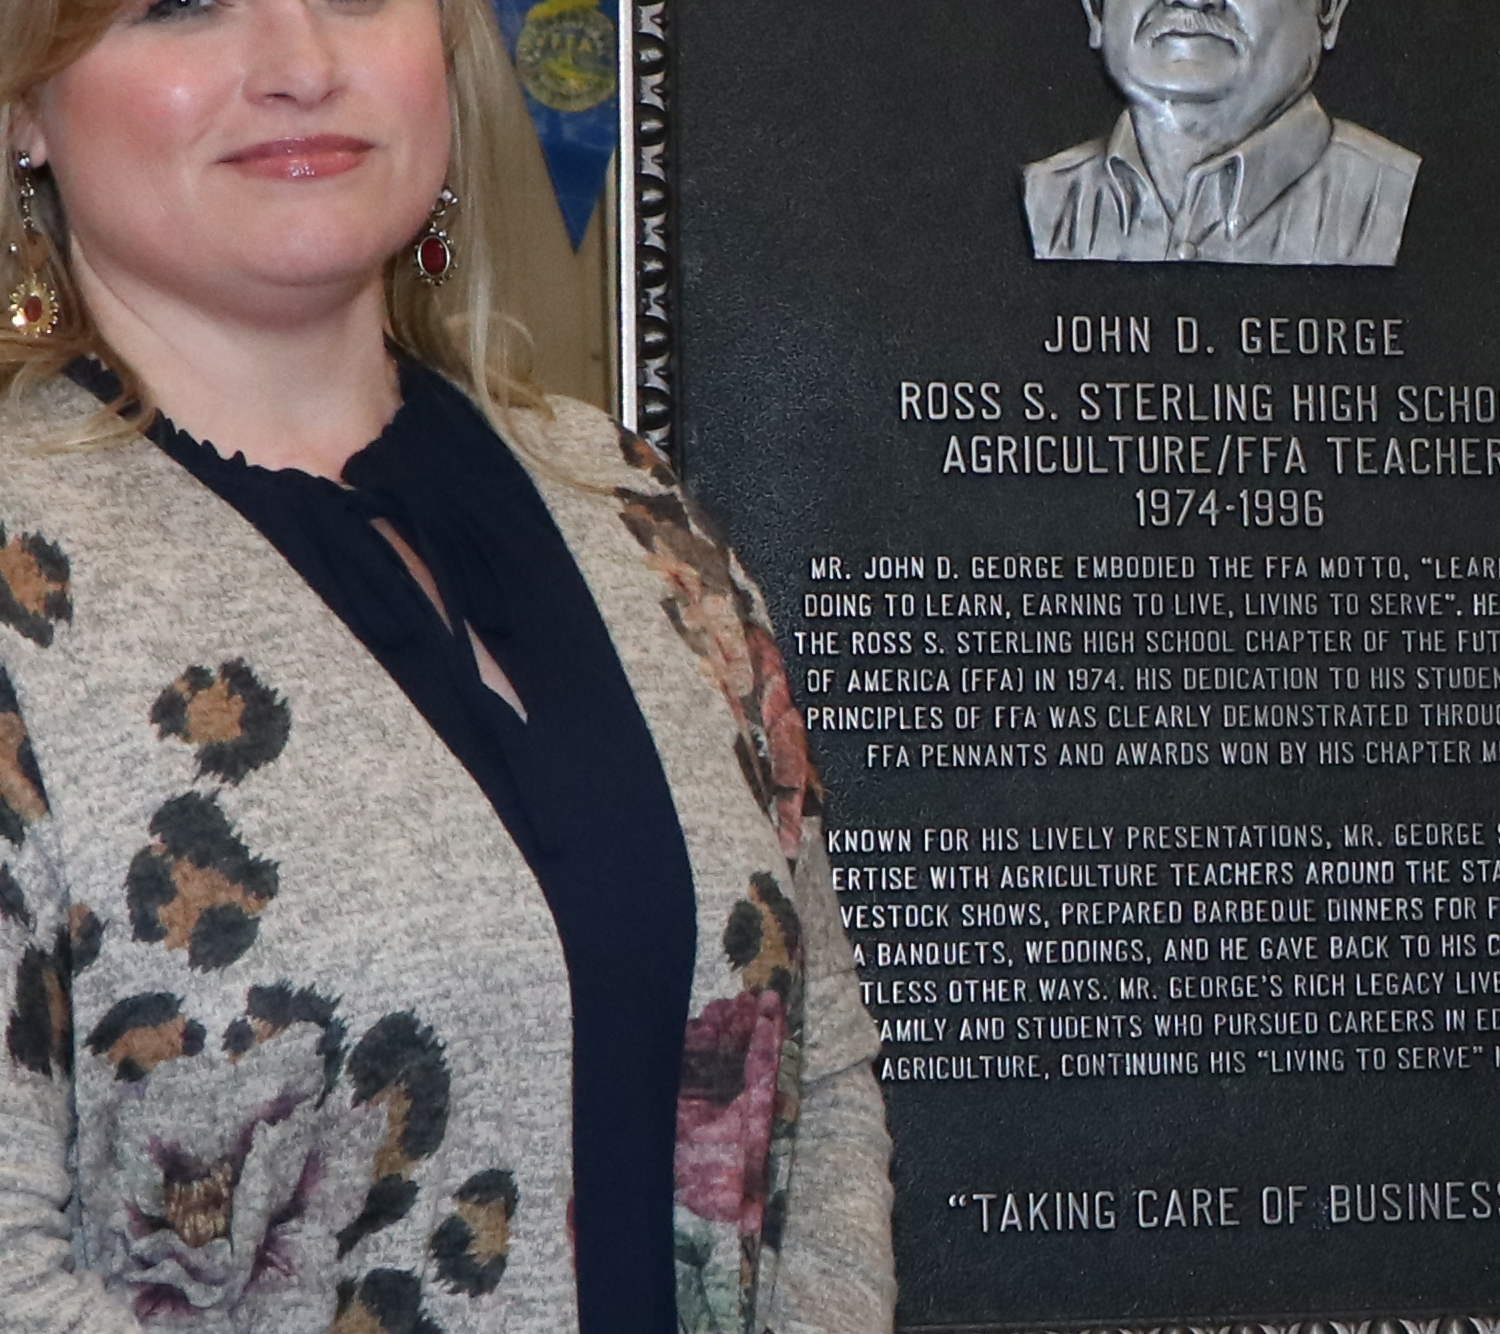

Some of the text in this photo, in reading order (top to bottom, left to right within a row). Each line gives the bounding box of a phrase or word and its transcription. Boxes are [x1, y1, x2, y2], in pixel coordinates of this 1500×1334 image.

[1044, 315, 1406, 355] JOHN D. GEORGE
[900, 380, 1002, 420] ROSS
[1023, 381, 1058, 421] S.
[1079, 381, 1273, 421] STERLING
[1292, 383, 1378, 422] HIGH
[942, 434, 1308, 474] AGRICULTURE/FFA
[1135, 487, 1324, 526] 1974-1996
[811, 555, 851, 580] MR.
[864, 555, 925, 580] JOHN
[936, 555, 959, 579] D.
[971, 555, 1064, 579] GEORGE
[1076, 555, 1195, 578] EMBODIED
[1208, 554, 1254, 578] THE
[1265, 555, 1308, 579] FFA
[1320, 555, 1410, 580] MOTTO,
[804, 592, 872, 617] DOING
[884, 592, 915, 617] TO
[926, 592, 1011, 619] LEARN,
[1022, 592, 1122, 616] EARNING
[1132, 592, 1164, 616] TO
[1174, 591, 1234, 618] LIVE,
[1245, 592, 1318, 615] LIVING
[1329, 592, 1359, 615] TO
[1473, 592, 1500, 616] HE
[794, 630, 838, 654] THE
[851, 630, 912, 654] ROSS
[923, 630, 947, 654] S.
[956, 630, 1072, 654] STERLING
[1083, 630, 1135, 654] HIGH
[1146, 630, 1236, 653] SCHOOL
[1245, 628, 1352, 652] CHAPTER
[1363, 629, 1390, 652] OF
[1401, 629, 1447, 652] THE
[806, 667, 835, 694] OF
[847, 668, 950, 692] AMERICA
[1035, 667, 1056, 691] IN
[1067, 667, 1125, 691] 1974.
[1136, 667, 1172, 691] HIS
[1183, 666, 1318, 690] DEDICATION
[1328, 666, 1360, 690] TO
[1370, 666, 1406, 689] HIS
[807, 705, 944, 730] PRINCIPLES
[955, 705, 984, 729] OF
[994, 705, 1038, 729] FFA
[1048, 704, 1097, 729] WAS
[1108, 704, 1212, 728] CLEARLY
[1223, 703, 1409, 727] DEMONSTRATED
[866, 743, 911, 768] FFA
[921, 742, 1048, 767] PENNANTS
[1058, 742, 1104, 766] AND
[1115, 741, 1210, 766] AWARDS
[1220, 741, 1269, 765] WON
[1279, 741, 1307, 765] BY
[1318, 740, 1355, 764] HIS
[1365, 739, 1471, 764] CHAPTER
[827, 828, 911, 854] KNOWN
[924, 827, 969, 851] FOR
[982, 826, 1020, 852] HIS
[1031, 826, 1114, 850] LIVELY
[1127, 824, 1332, 849] PRESENTATIONS,
[1343, 823, 1383, 847] MR.
[1394, 822, 1485, 847] GEORGE
[831, 866, 919, 892] ERTISE
[929, 865, 989, 890] WITH
[1000, 862, 1158, 888] AGRICULTURE
[1169, 860, 1294, 886] TEACHERS
[1305, 859, 1394, 885] AROUND
[1404, 858, 1451, 884] THE
[839, 904, 950, 930] VESTOCK
[961, 902, 1050, 927] SHOWS,
[1061, 899, 1182, 925] PREPARED
[1193, 898, 1316, 923] BARBEQUE
[1327, 896, 1424, 922] DINNERS
[1434, 896, 1477, 920] FOR
[877, 940, 1014, 966] BANQUETS,
[1025, 938, 1152, 964] WEDDINGS,
[1164, 936, 1209, 961] AND
[1220, 936, 1249, 961] HE
[1260, 935, 1318, 960] GAVE
[1329, 934, 1389, 959] BACK
[1399, 933, 1431, 958] TO
[1441, 933, 1477, 957] HIS
[859, 980, 938, 1005] TLESS
[948, 978, 1027, 1003] OTHER
[1038, 976, 1109, 1001] WAYS.
[1119, 976, 1159, 1000] MR.
[1294, 972, 1345, 997] RICH
[1355, 971, 1445, 996] LEGACY
[873, 1017, 948, 1043] AMILY
[959, 1016, 1005, 1041] AND
[1016, 1014, 1143, 1040] STUDENTS
[1154, 1013, 1203, 1037] WHO
[1214, 1011, 1318, 1035] PURSUED
[1329, 1009, 1435, 1033] CAREERS
[1445, 1008, 1466, 1031] IN
[881, 1054, 1050, 1080] AGRICULTURE,
[1061, 1051, 1199, 1076] CONTINUING
[1210, 1049, 1246, 1074] HIS
[1355, 1046, 1386, 1071] TO
[1136, 1187, 1242, 1229] CARE
[1262, 1184, 1309, 1227] OF
